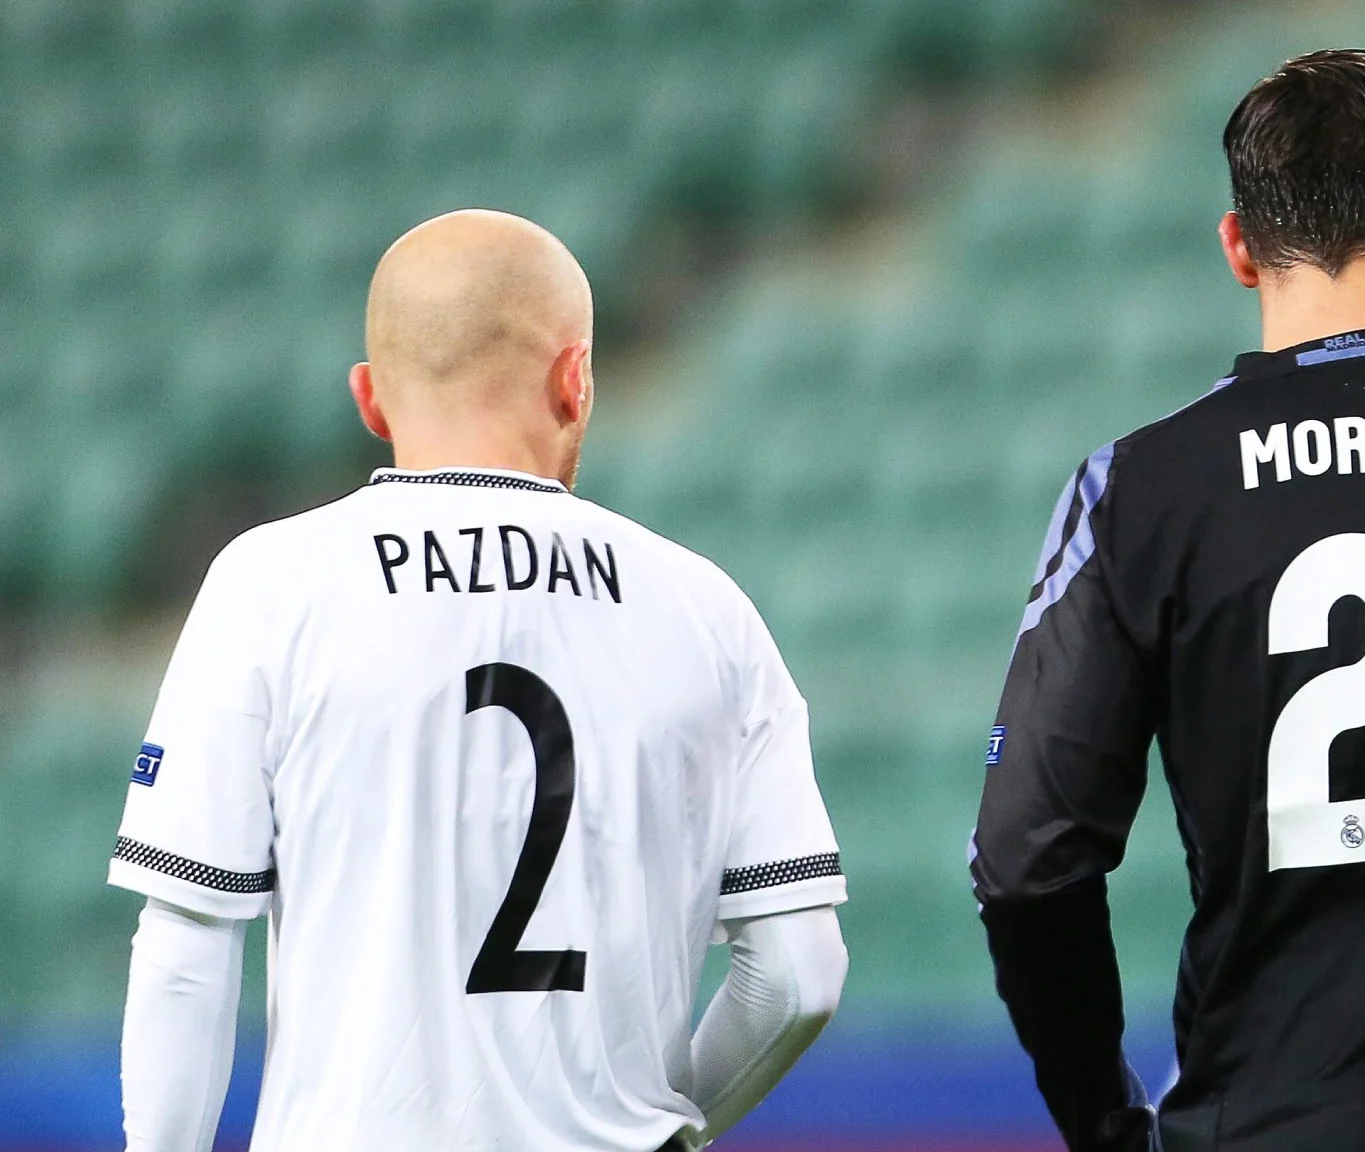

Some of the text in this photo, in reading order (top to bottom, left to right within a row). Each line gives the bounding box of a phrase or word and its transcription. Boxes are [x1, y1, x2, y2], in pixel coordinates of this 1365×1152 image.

[1323, 332, 1365, 351] REAL
[373, 524, 622, 604] PAZDAN
[465, 662, 587, 995] 2
